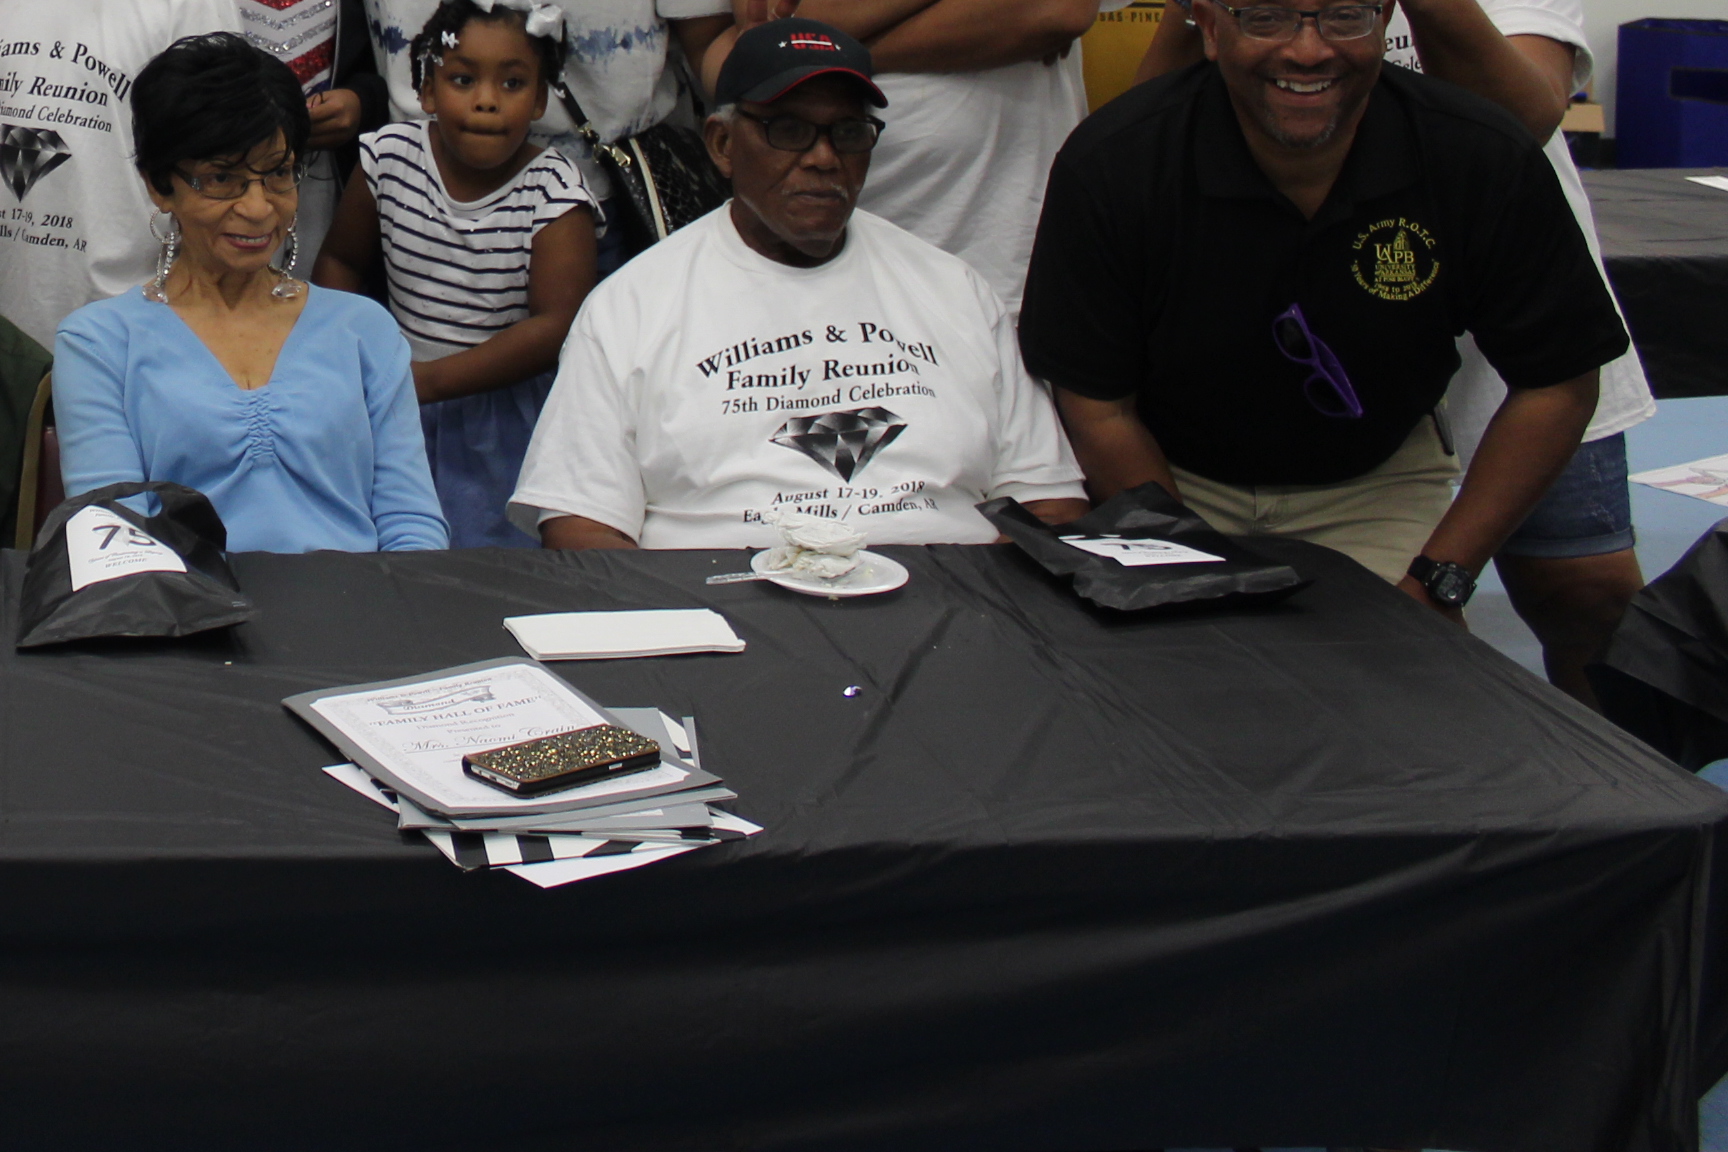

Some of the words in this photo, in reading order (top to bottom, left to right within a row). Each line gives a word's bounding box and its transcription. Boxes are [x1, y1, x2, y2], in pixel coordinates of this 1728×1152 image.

[790, 32, 836, 52] USA
[49, 40, 65, 60] &
[70, 42, 131, 103] Powell
[28, 76, 108, 107] Reunion
[37, 105, 112, 133] Celebration
[41, 214, 73, 229] 2018
[1369, 218, 1395, 233] Army
[73, 238, 87, 253] AR
[696, 327, 814, 379] Williams
[825, 324, 847, 344] &
[725, 364, 812, 391] Family
[822, 353, 920, 382] Reunion
[721, 397, 759, 415] 75th
[765, 389, 841, 412] Diamond
[848, 382, 936, 402] Celebration
[772, 488, 829, 505] August
[890, 481, 926, 494] 2018
[857, 497, 922, 516] Camden,
[432, 710, 472, 720] HALL
[474, 704, 494, 713] OF
